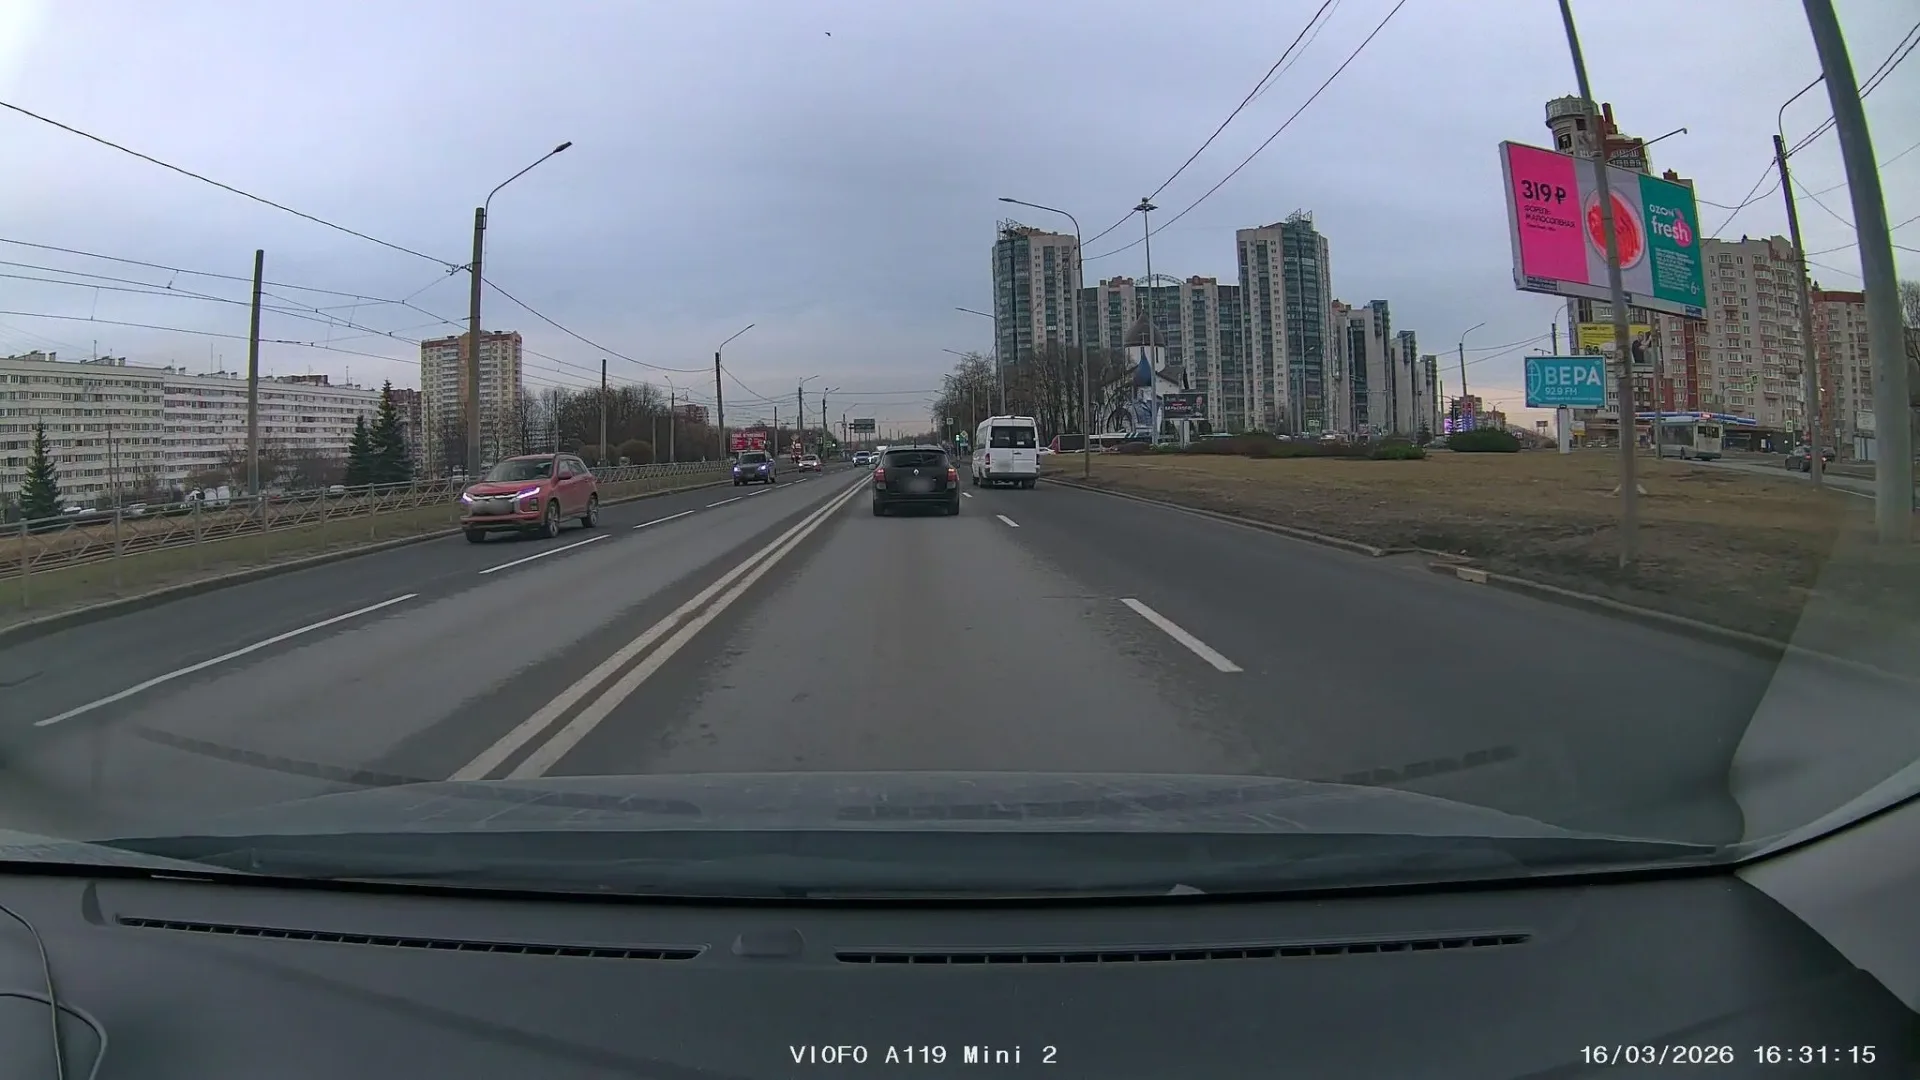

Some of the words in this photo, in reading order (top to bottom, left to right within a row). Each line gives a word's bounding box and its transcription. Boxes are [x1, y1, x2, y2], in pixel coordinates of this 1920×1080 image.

[1521, 179, 1552, 202] 319
[1651, 215, 1690, 242] fresh
[1544, 366, 1602, 386] ВЕРА
[1564, 387, 1578, 395] FM
